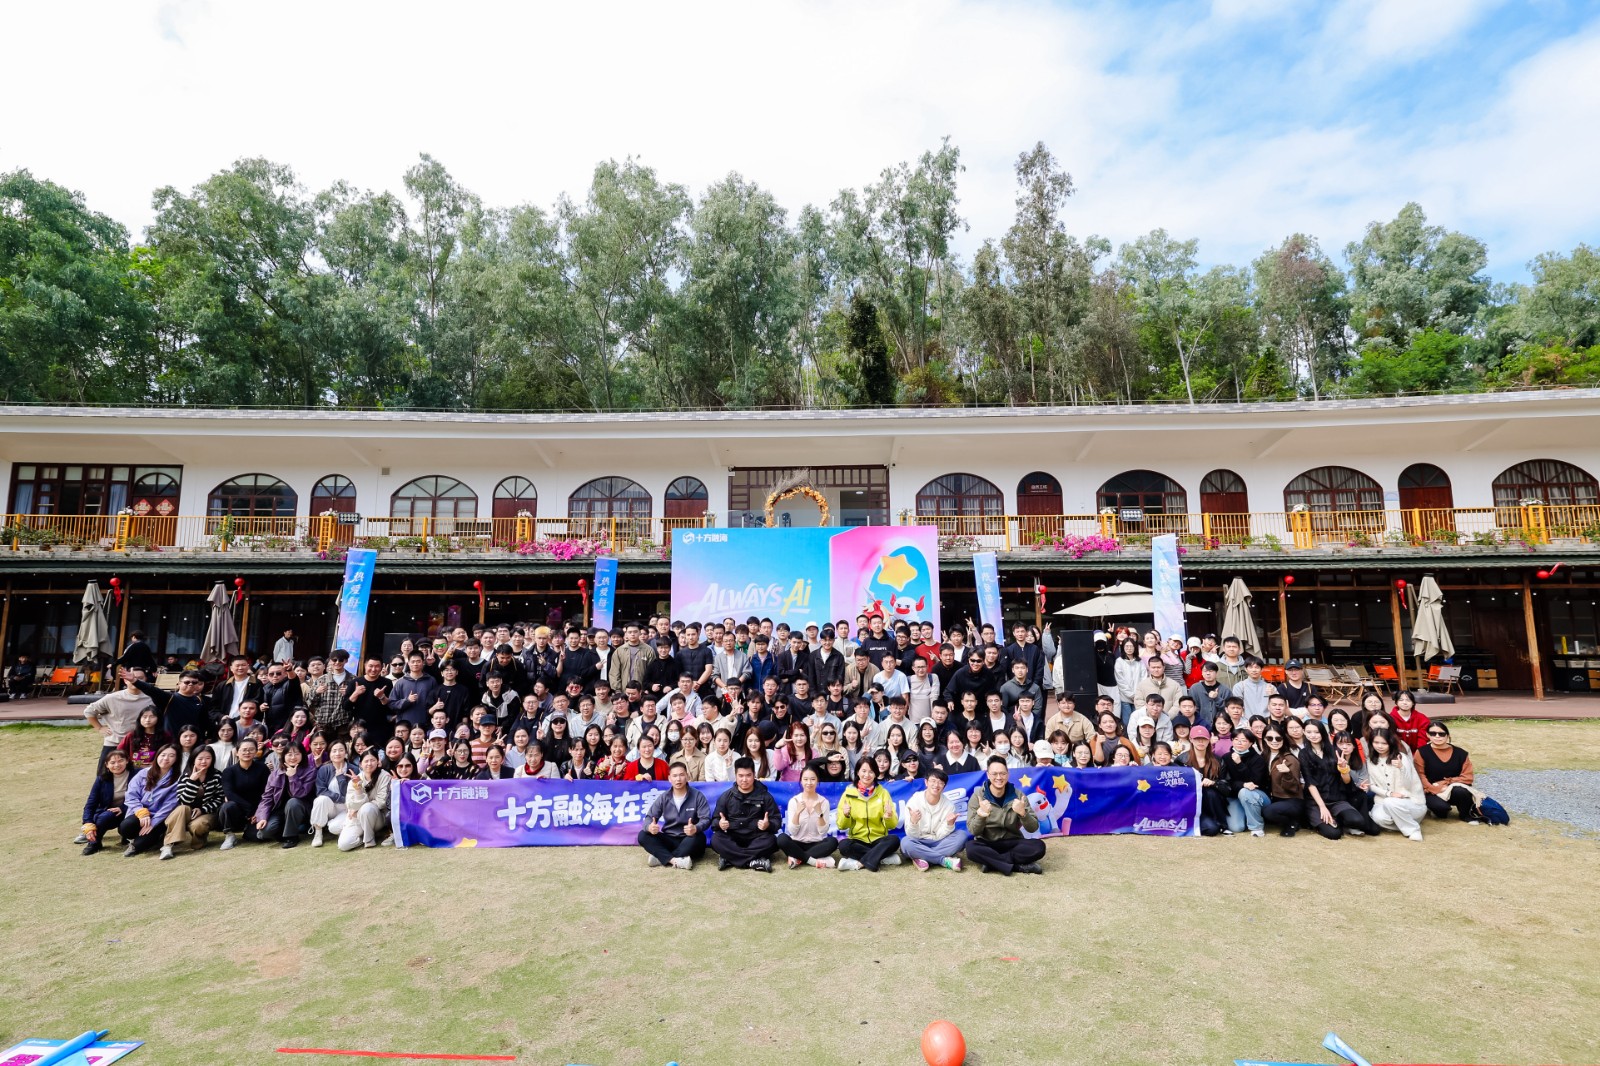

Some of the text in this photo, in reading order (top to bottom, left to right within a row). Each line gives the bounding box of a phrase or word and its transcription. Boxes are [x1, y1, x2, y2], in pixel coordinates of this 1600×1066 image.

[700, 583, 784, 613] ALWAYS
[433, 786, 489, 800] 十方融海
[1134, 817, 1177, 831] ALWAYS
